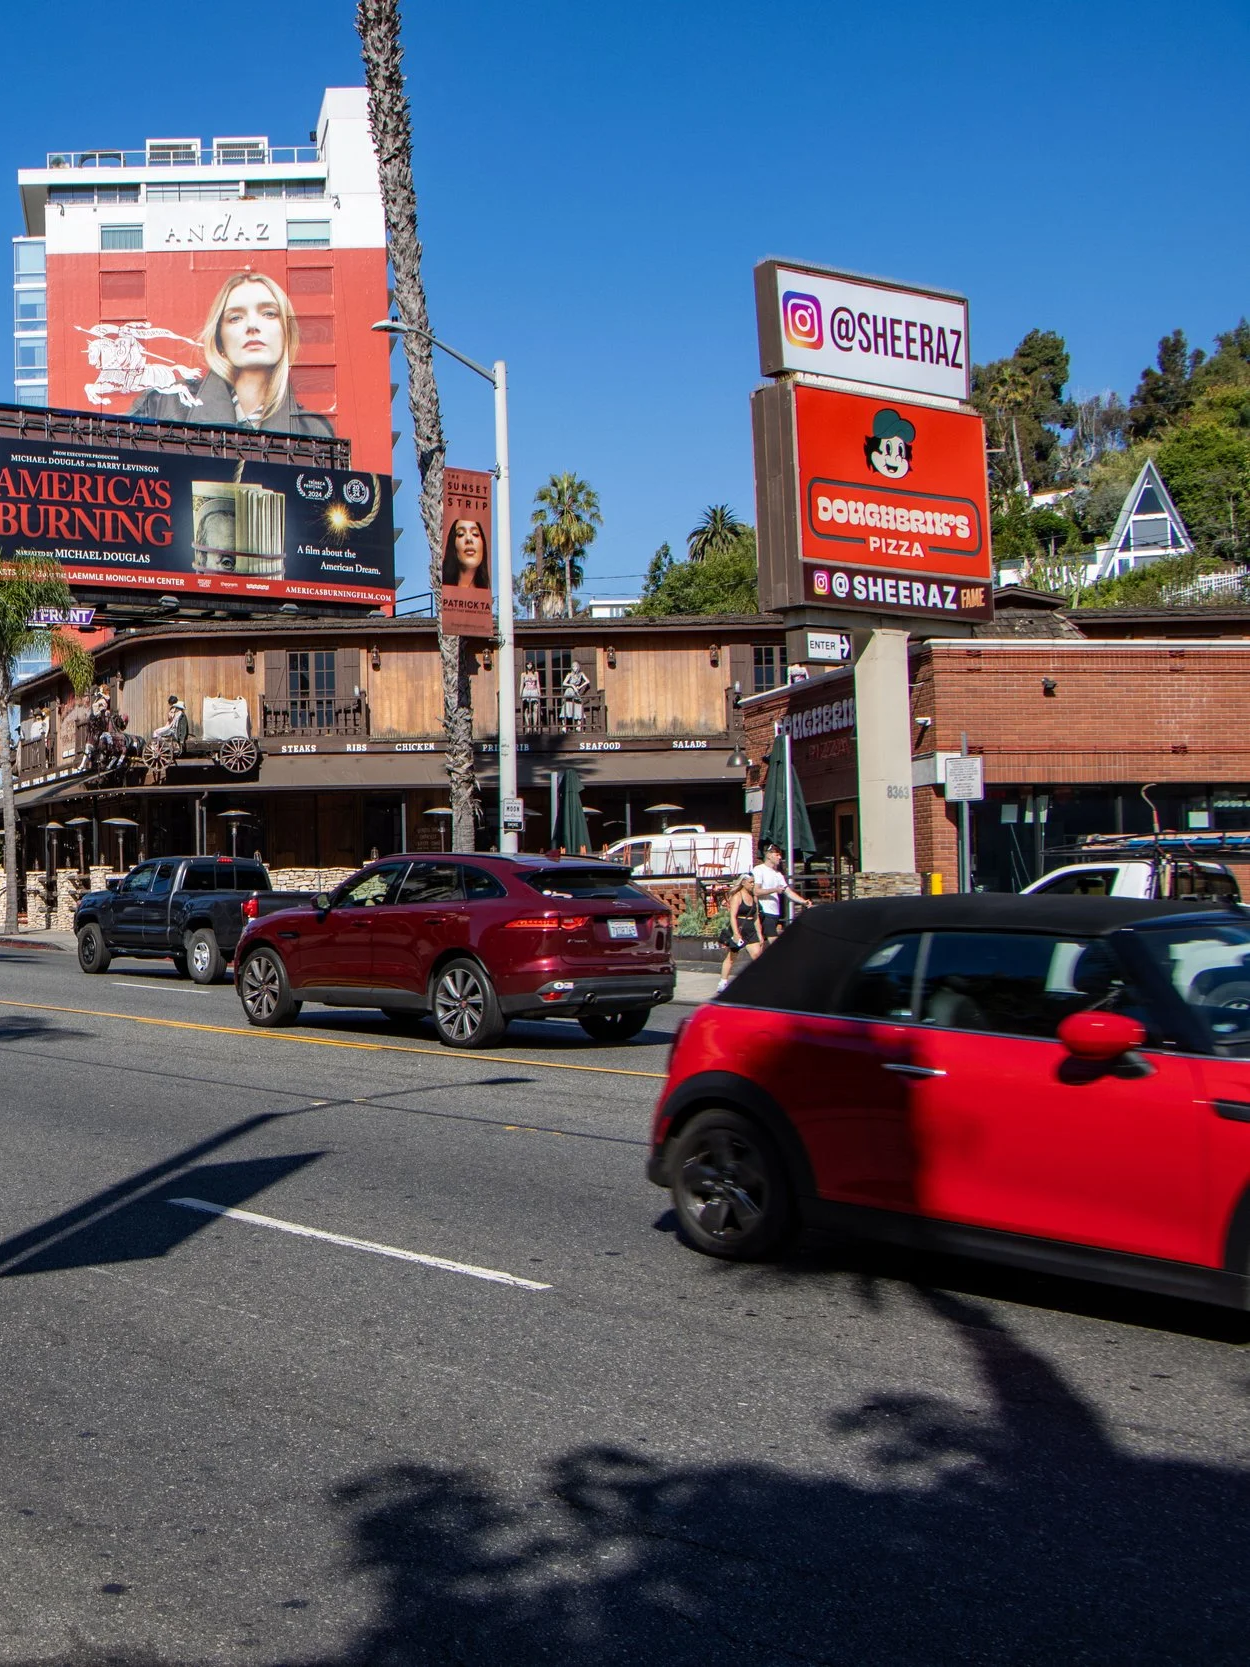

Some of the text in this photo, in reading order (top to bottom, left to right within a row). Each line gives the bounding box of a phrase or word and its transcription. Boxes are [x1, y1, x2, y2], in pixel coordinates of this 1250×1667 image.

[830, 306, 963, 369] @SHEERAZ
[66, 451, 92, 459] EXECUTIVE
[10, 454, 47, 464] MICHAEL
[48, 457, 85, 467] DOUGLAS
[96, 461, 121, 471] BARRY
[122, 463, 159, 473] LEVINSON
[447, 481, 488, 494] SUNSET
[448, 498, 488, 511] STRIP
[817, 496, 971, 539] DOUGHBRIK'S
[297, 546, 357, 559] A film about the
[869, 536, 925, 558] PIZZA
[54, 548, 102, 560] MICHAEL
[103, 551, 151, 564] DOUGLAS
[320, 561, 381, 575] American Dream.
[68, 572, 104, 582] LAEMMLE
[105, 573, 137, 583] MONICA
[138, 575, 155, 584] FILM
[156, 577, 185, 586] CENTER
[285, 586, 392, 602] AMERICASBURNINGFILM.COM
[960, 587, 986, 609] FAME
[443, 599, 491, 610] PATRICK TA
[809, 640, 836, 651] ENTER
[281, 745, 317, 753] STEAKS
[346, 743, 368, 752] RIBS
[395, 742, 435, 752] CHICKEN
[579, 742, 621, 750] SEAFOOD
[672, 740, 707, 749] SALADS
[886, 785, 910, 800] 8363
